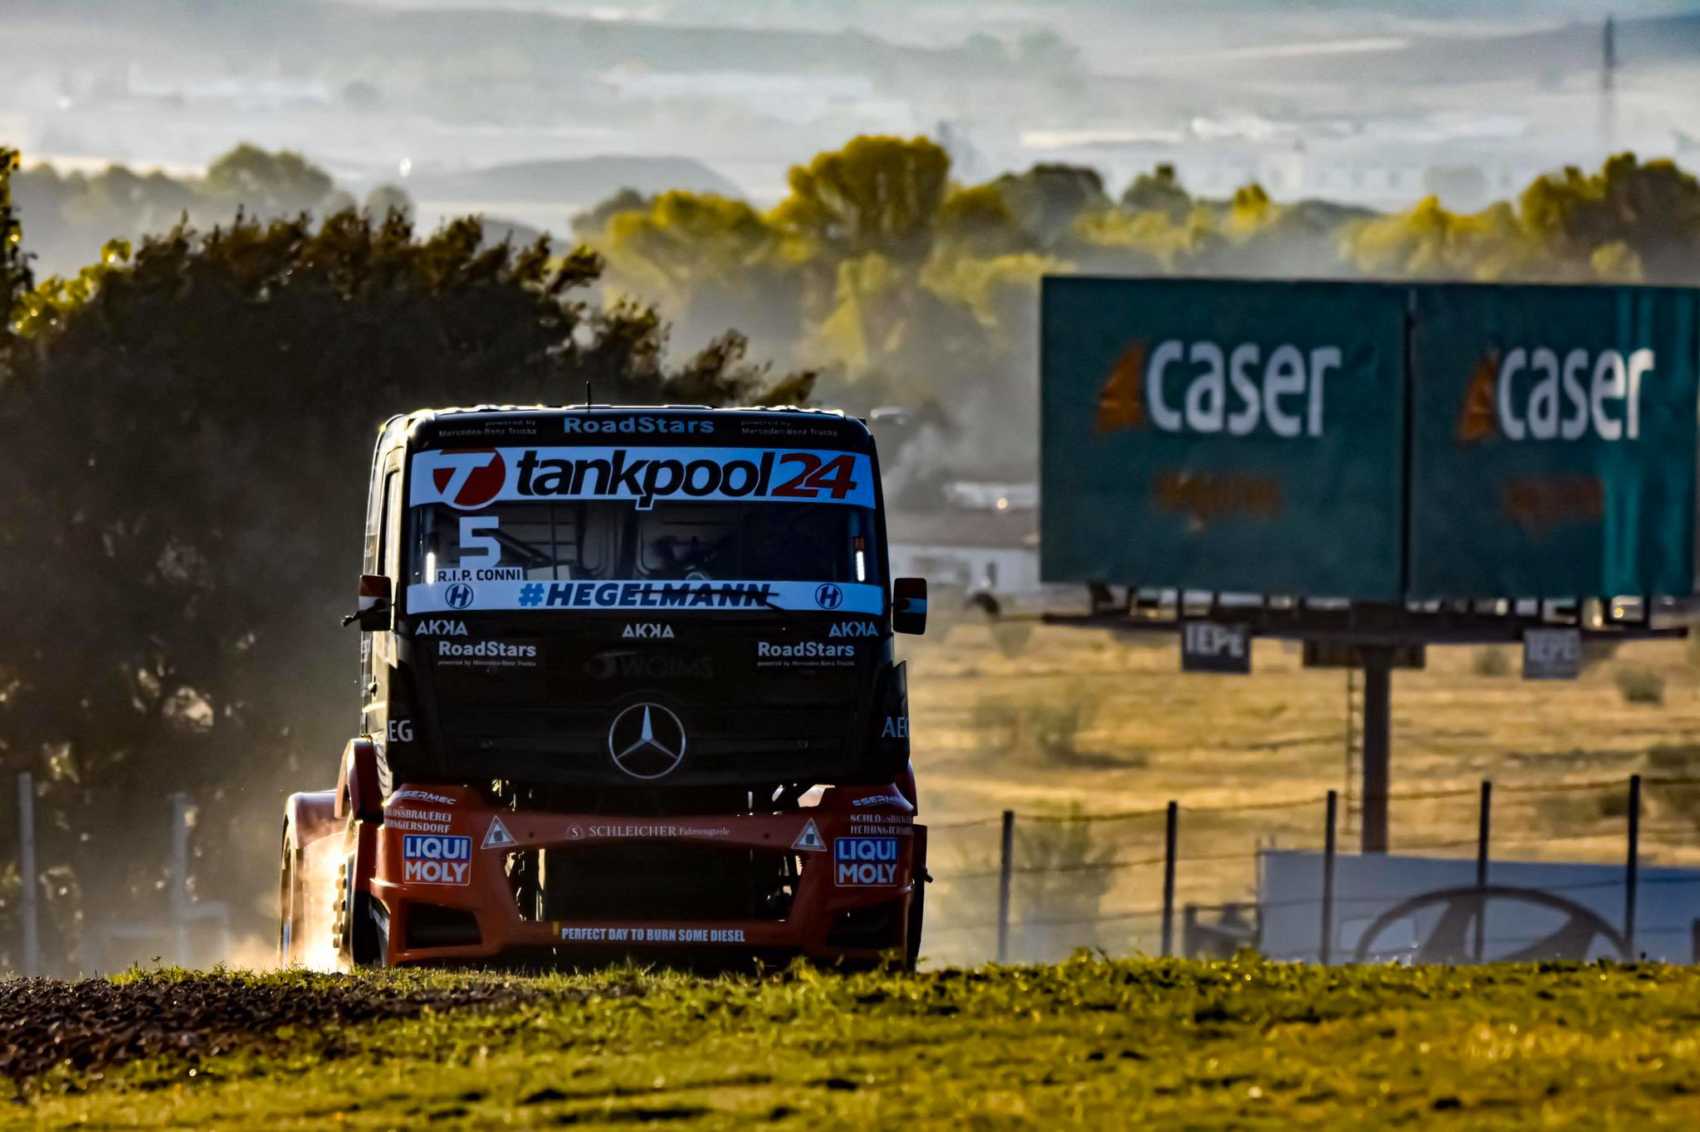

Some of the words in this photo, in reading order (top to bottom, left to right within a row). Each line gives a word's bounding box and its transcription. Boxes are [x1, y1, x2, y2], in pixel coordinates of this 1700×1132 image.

[1147, 339, 1342, 438] caser
[1498, 347, 1655, 440] caser
[563, 416, 715, 434] RoadStars
[516, 449, 857, 510] tankpool24
[459, 516, 501, 568] 5
[438, 569, 472, 582] R.I.P.
[476, 569, 521, 582] CONNI
[518, 582, 770, 608] #HEGELMANN
[439, 641, 537, 657] RoadStars
[757, 642, 855, 657] RoadStars
[387, 720, 414, 742] EG
[588, 826, 677, 838] SCHLEICHER
[406, 837, 467, 859] LIQUI
[838, 840, 896, 860] LIQUI
[405, 861, 467, 883] MOLY
[838, 863, 897, 884] MOLY
[562, 928, 607, 940] PERFECT
[608, 928, 629, 940] DAY
[631, 929, 644, 940] TO
[648, 929, 676, 941] BURN
[678, 929, 708, 942] SOME
[710, 930, 745, 942] DIESEL
